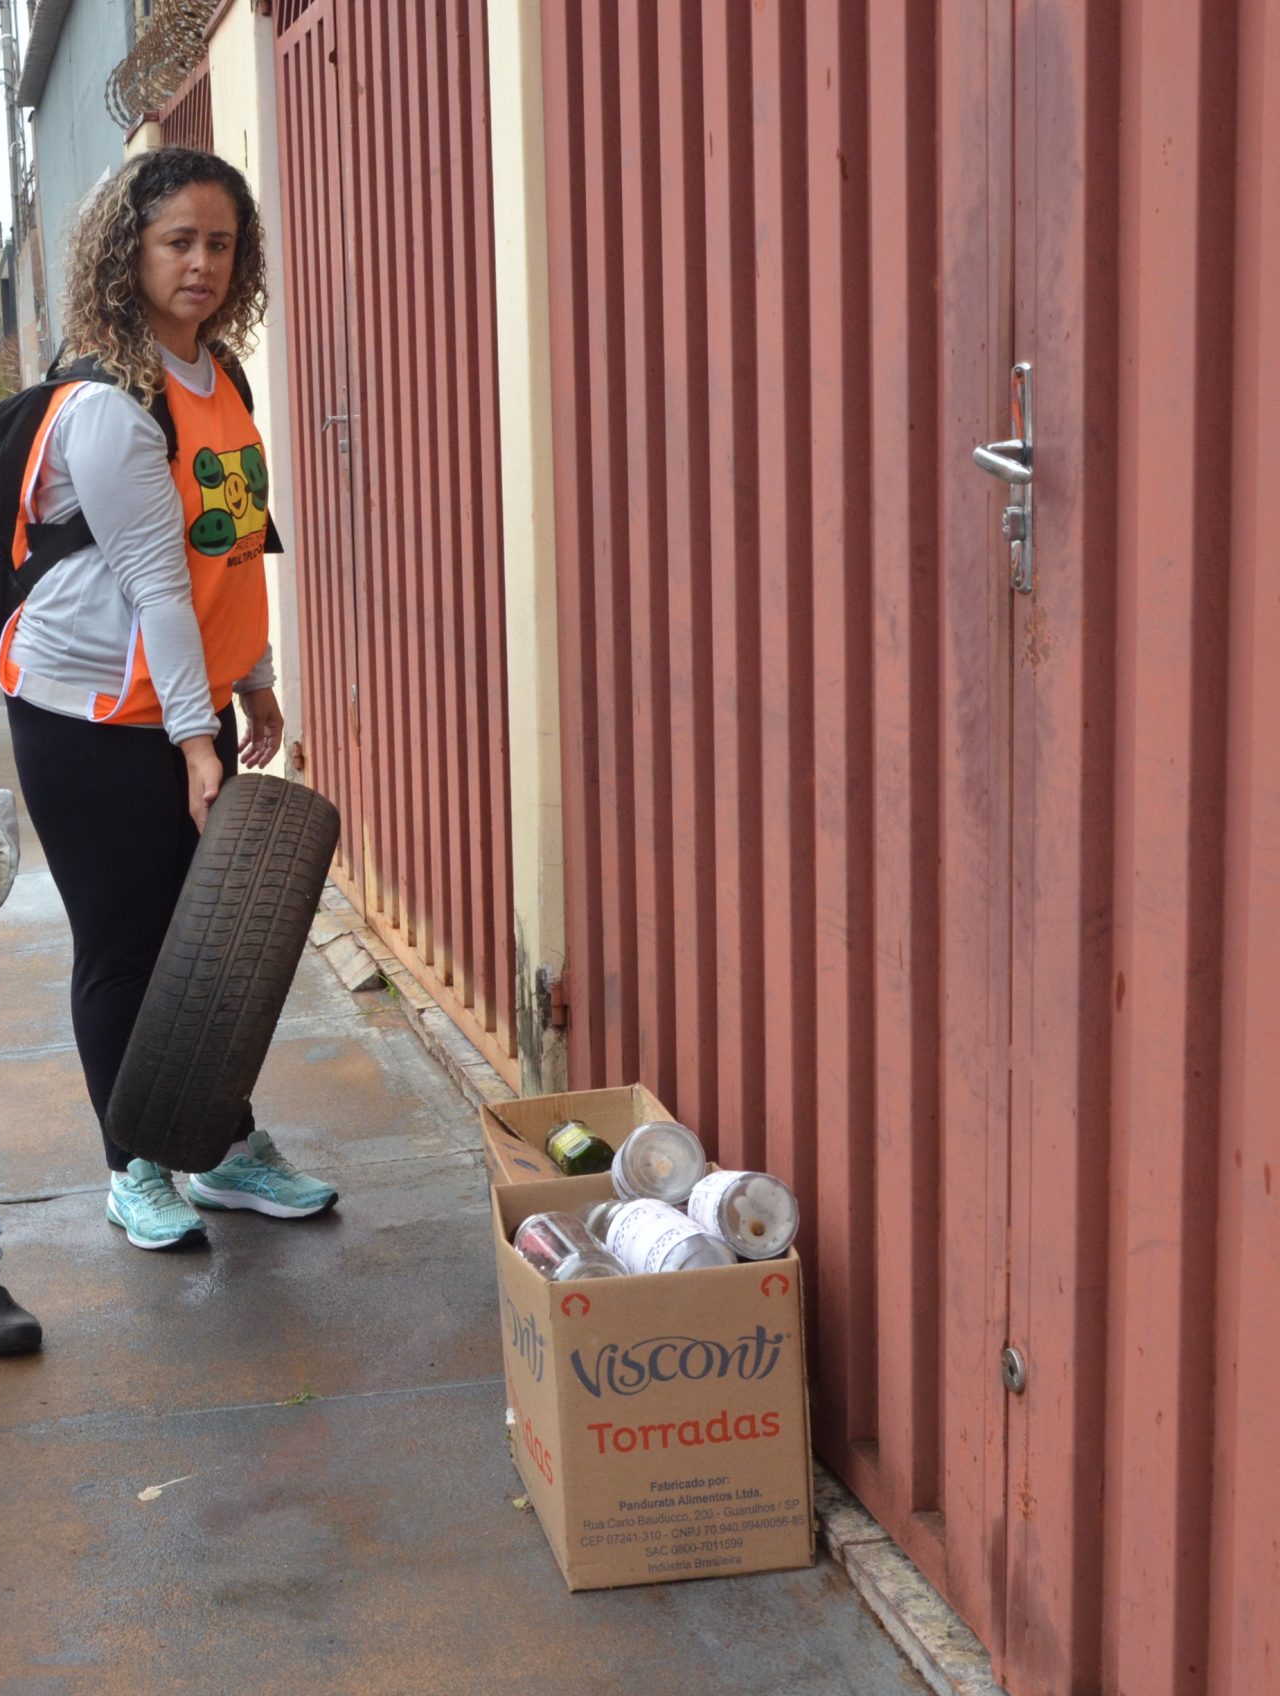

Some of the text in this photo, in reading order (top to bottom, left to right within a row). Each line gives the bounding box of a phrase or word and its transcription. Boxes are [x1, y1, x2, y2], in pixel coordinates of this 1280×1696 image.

[571, 1325, 784, 1398] Visconti
[587, 1410, 780, 1454] Torradas
[650, 1476, 730, 1492] Fabricado por:
[619, 1487, 762, 1511] Pandurata Alimentos Ltda.
[583, 1520, 605, 1531] Rua
[607, 1517, 635, 1529] Carlo
[694, 1508, 713, 1520] 200
[723, 1503, 776, 1517] Guarulhos
[784, 1499, 800, 1510] SP
[580, 1536, 604, 1547] CEP
[606, 1530, 662, 1545] 07241-310
[671, 1526, 700, 1539] CNPJ
[645, 1538, 744, 1557] SAC 0800-7011599
